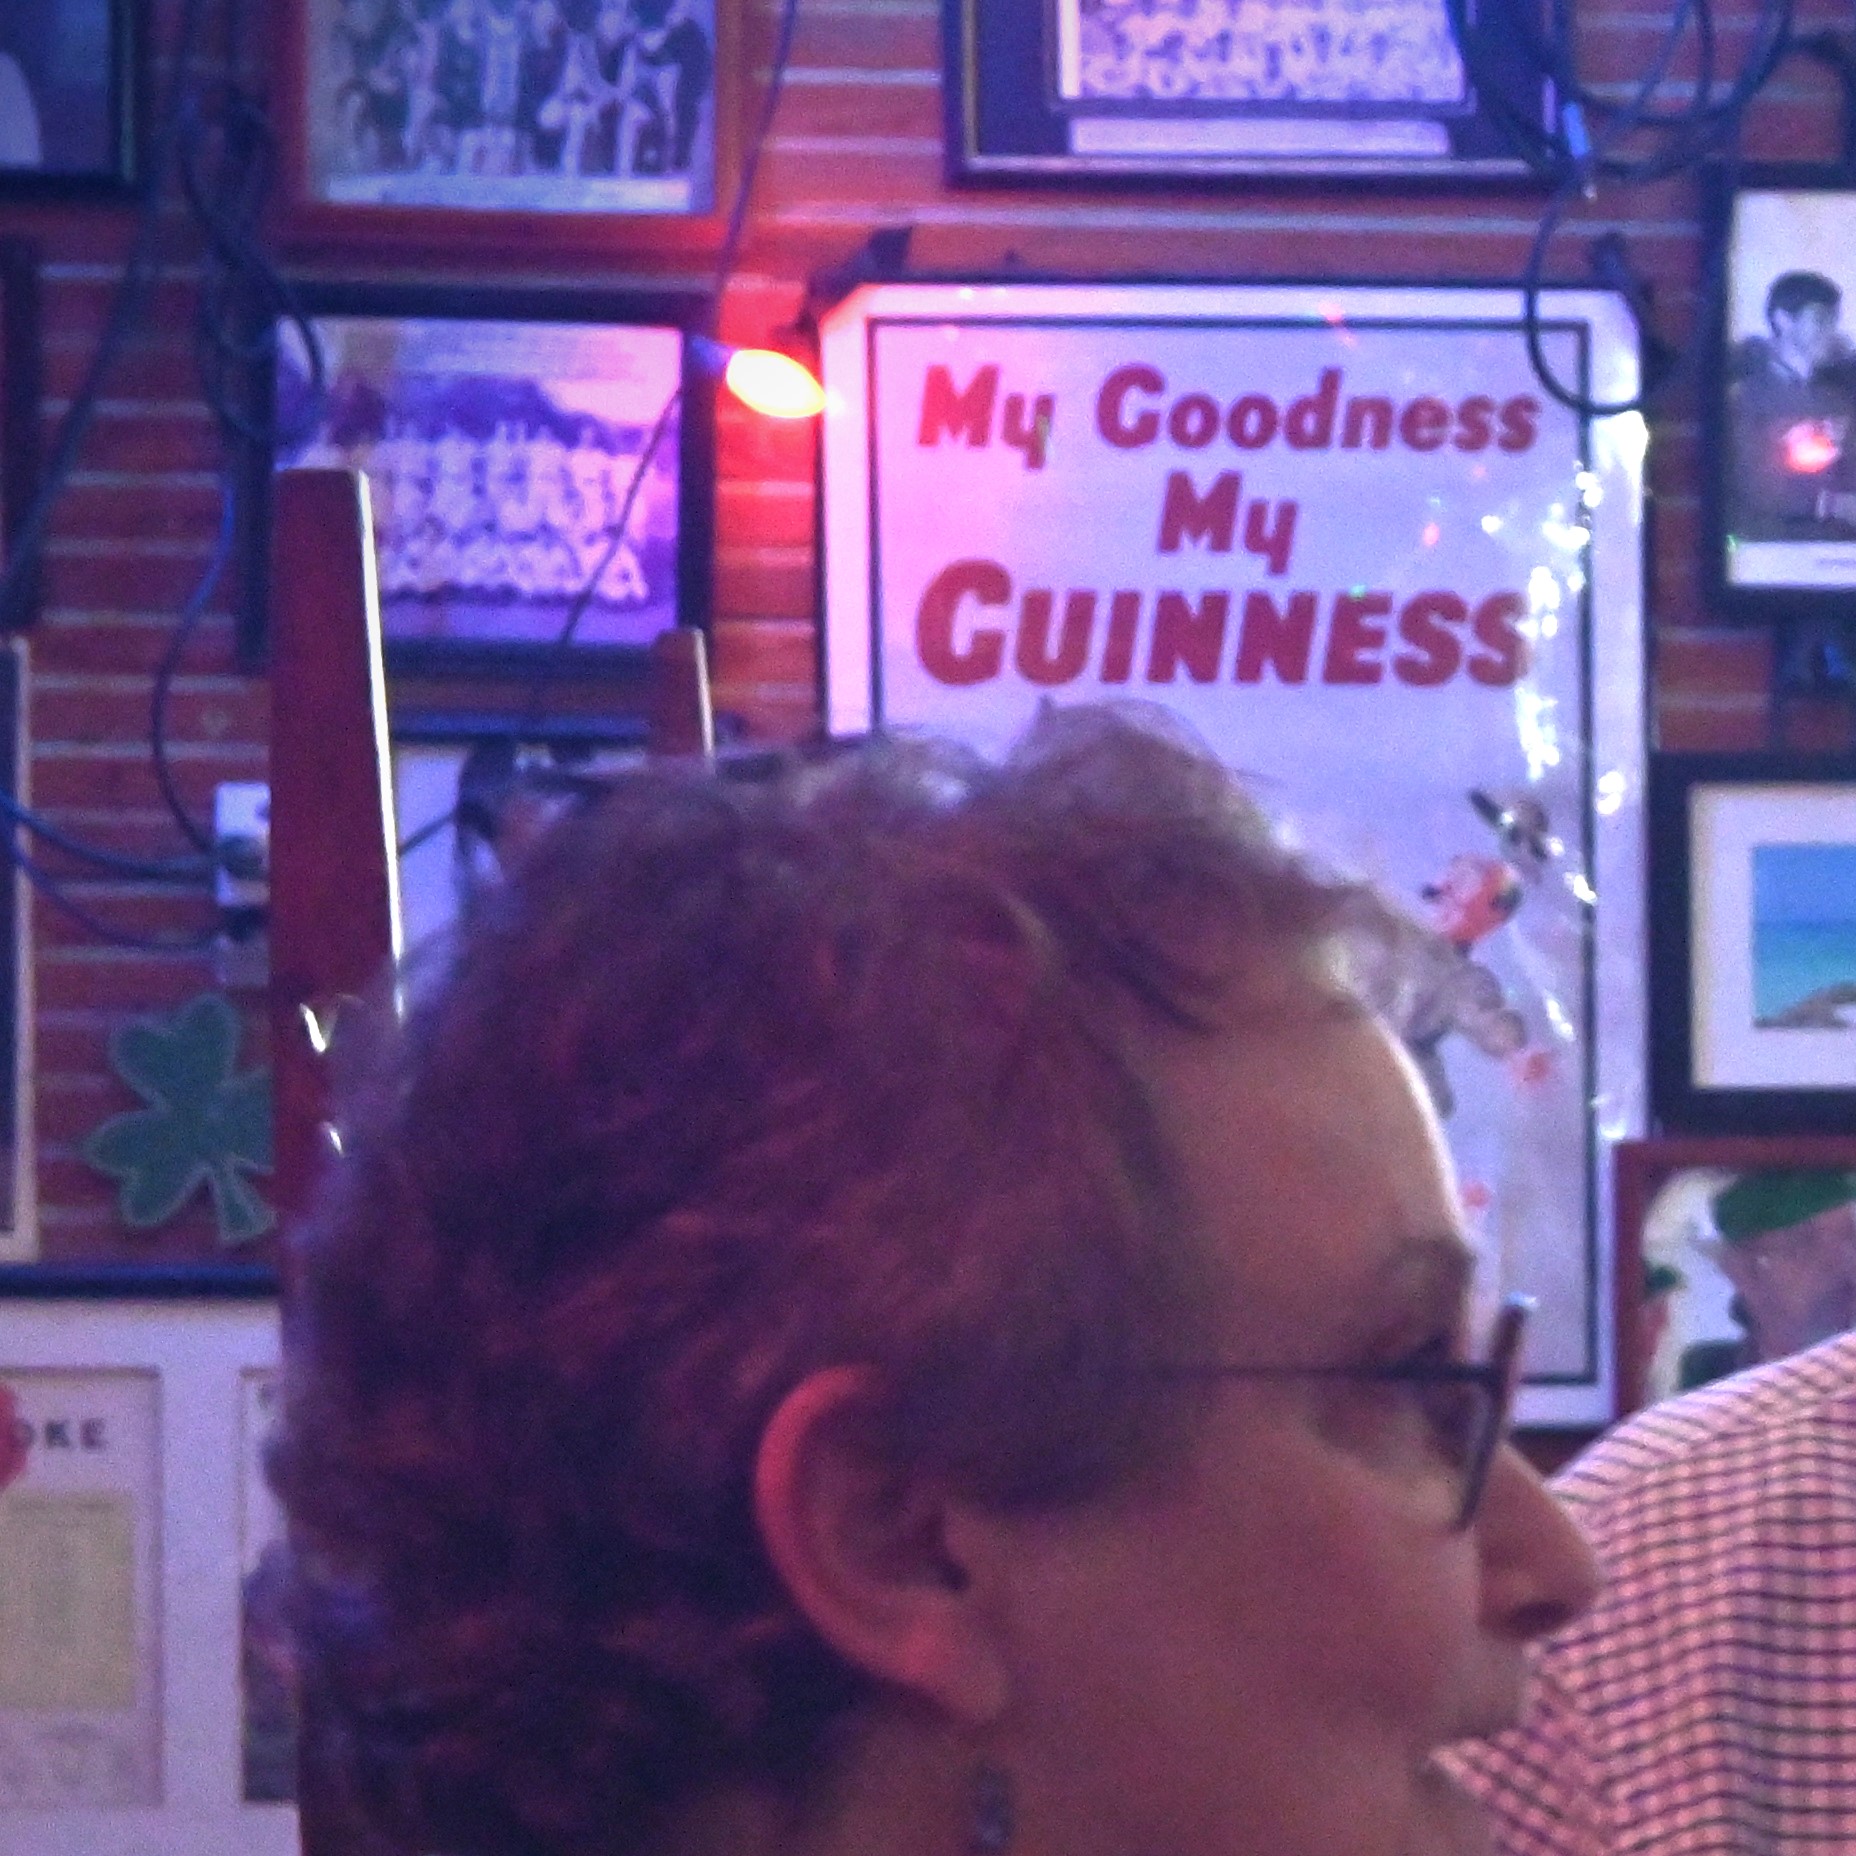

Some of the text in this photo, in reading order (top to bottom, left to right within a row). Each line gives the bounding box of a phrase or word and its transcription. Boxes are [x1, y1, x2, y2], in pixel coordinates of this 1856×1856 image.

[917, 364, 1540, 471] My Goodness
[1158, 471, 1299, 576] My
[915, 559, 1527, 688] GUINNESS
